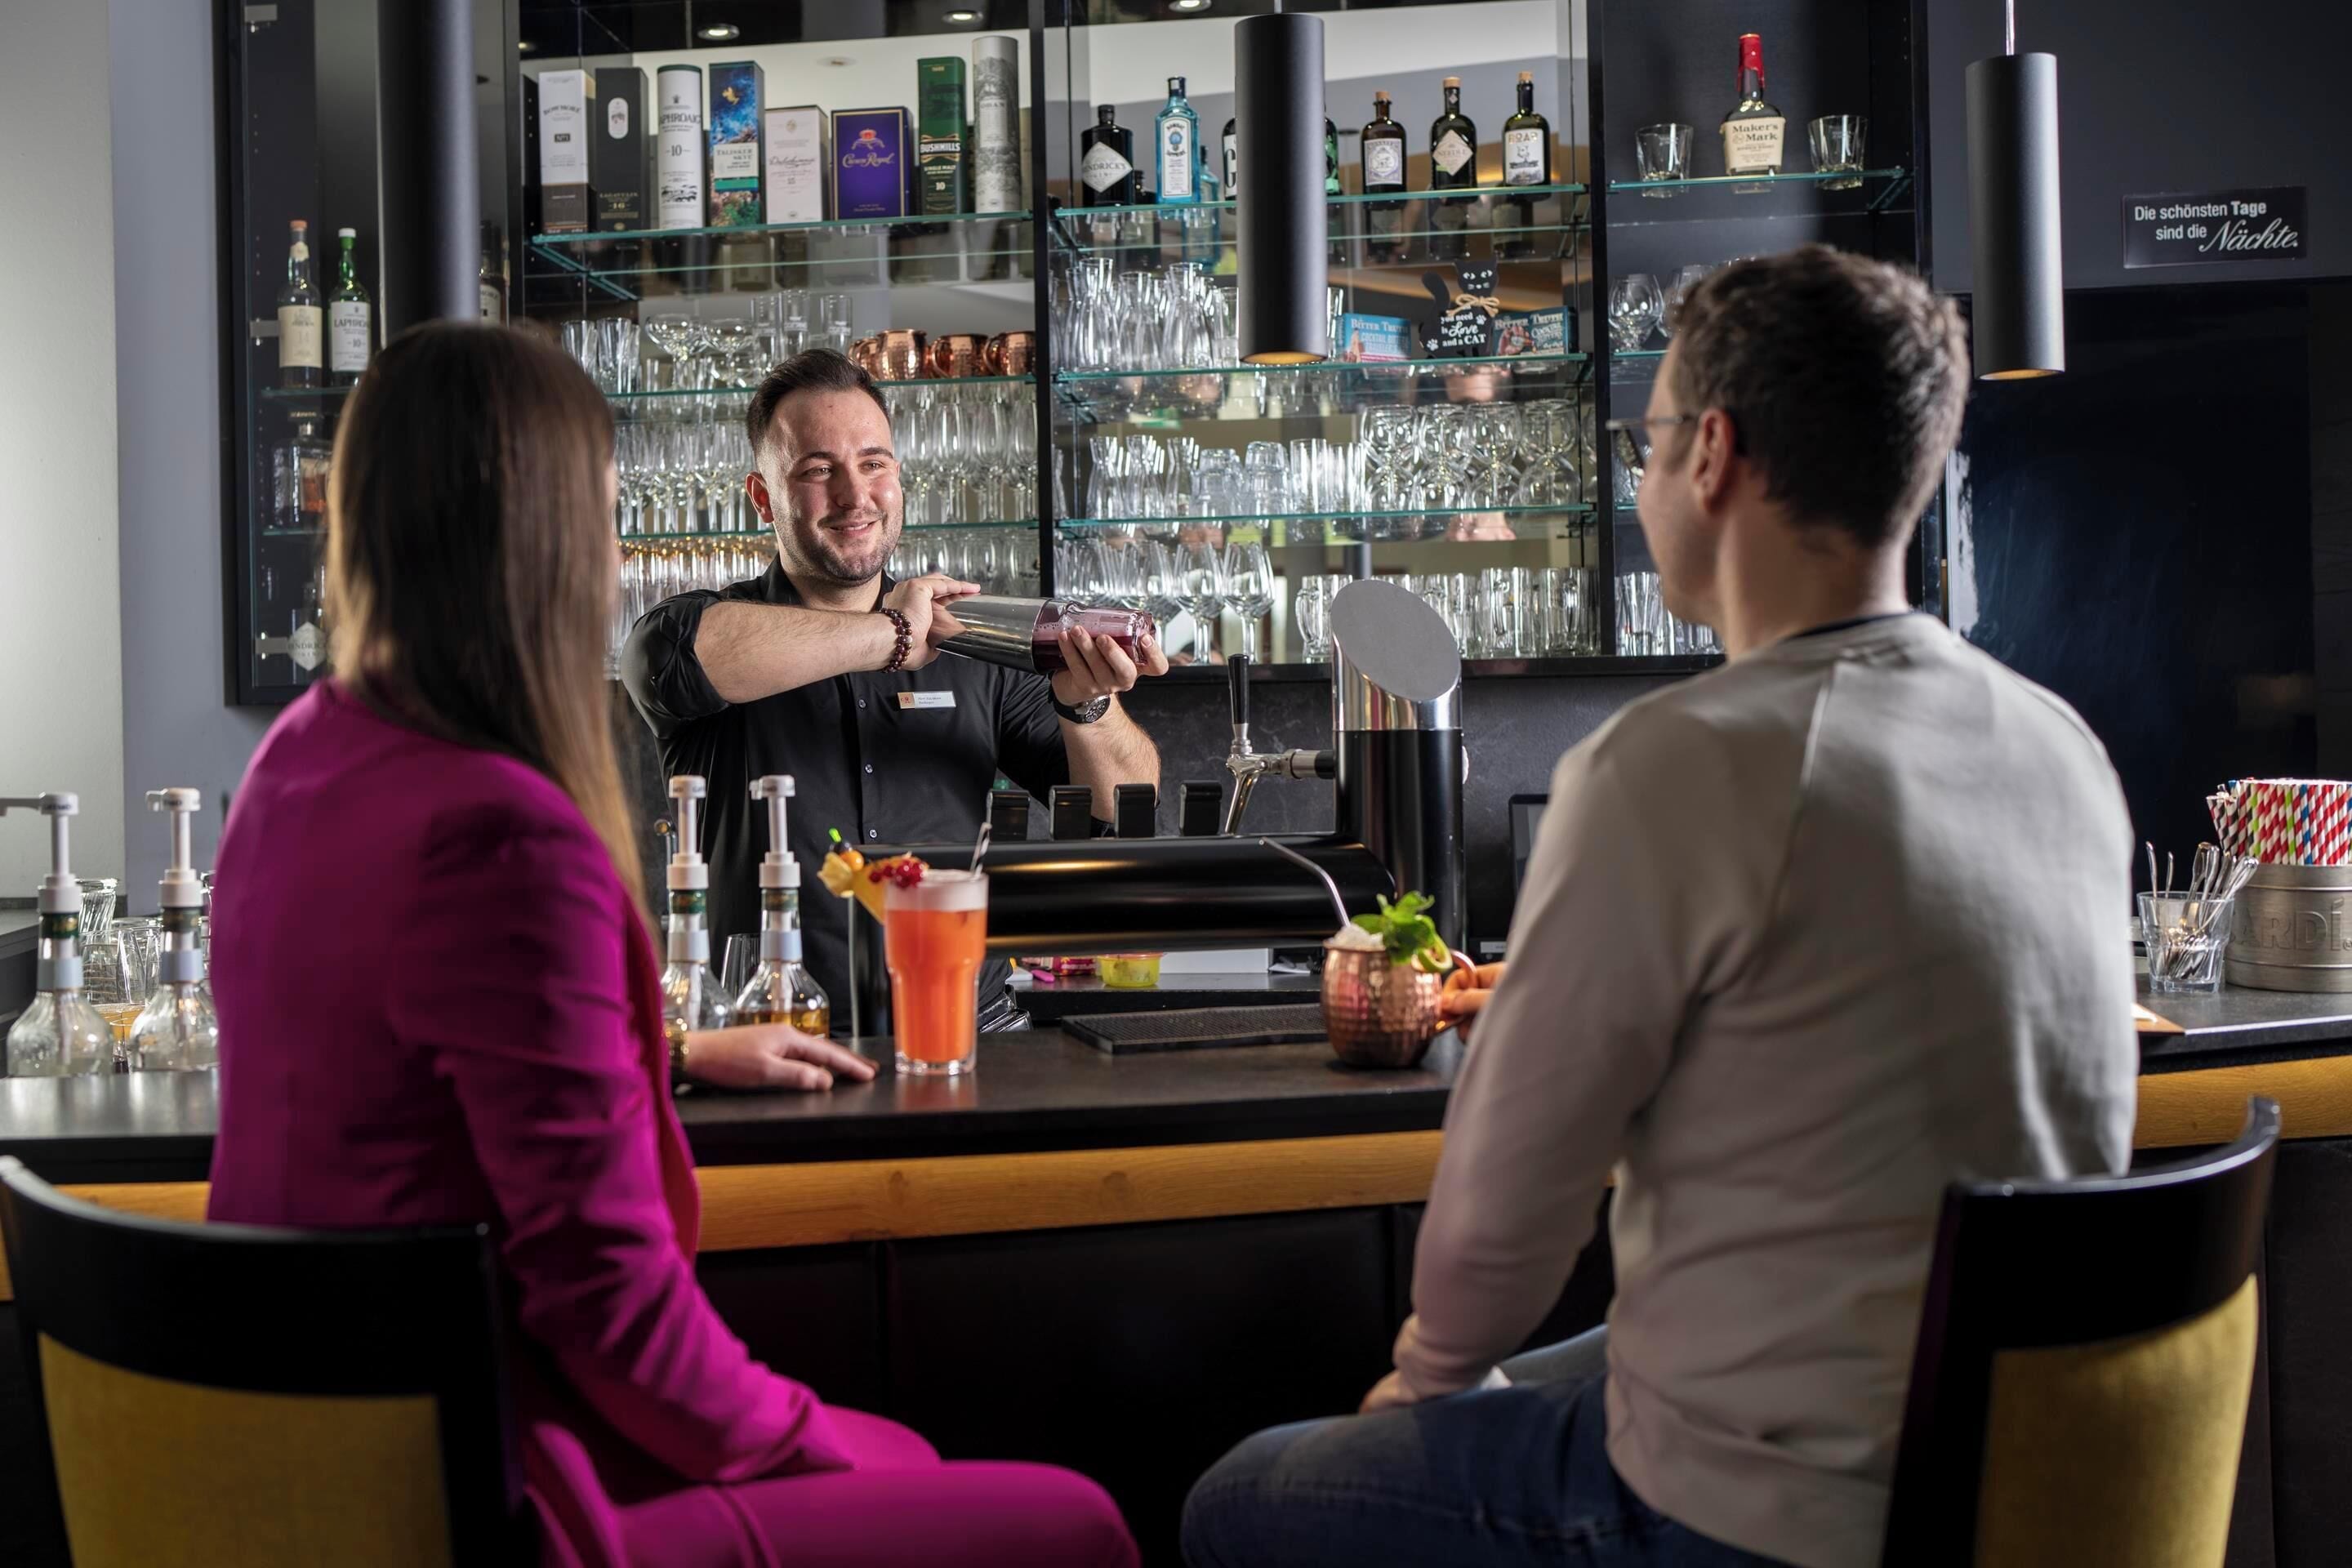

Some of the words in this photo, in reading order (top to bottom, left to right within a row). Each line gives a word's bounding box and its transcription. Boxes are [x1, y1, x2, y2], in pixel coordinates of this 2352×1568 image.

[1732, 124, 1778, 133] Maker's
[1746, 133, 1777, 141] Mark
[671, 145, 682, 156] 10
[920, 142, 960, 154] BUSHMILLS
[936, 181, 946, 190] 10
[2135, 207, 2156, 221] Die
[2159, 203, 2228, 220] schönsten
[2230, 201, 2266, 218] Tage
[2156, 225, 2184, 240] sind
[2187, 224, 2207, 238] die
[2198, 217, 2299, 252] Nächte.
[1455, 312, 1473, 321] need
[1449, 321, 1478, 337] Love
[353, 339, 361, 348] 10
[1442, 338, 1457, 346] and
[1464, 333, 1486, 345] CAT
